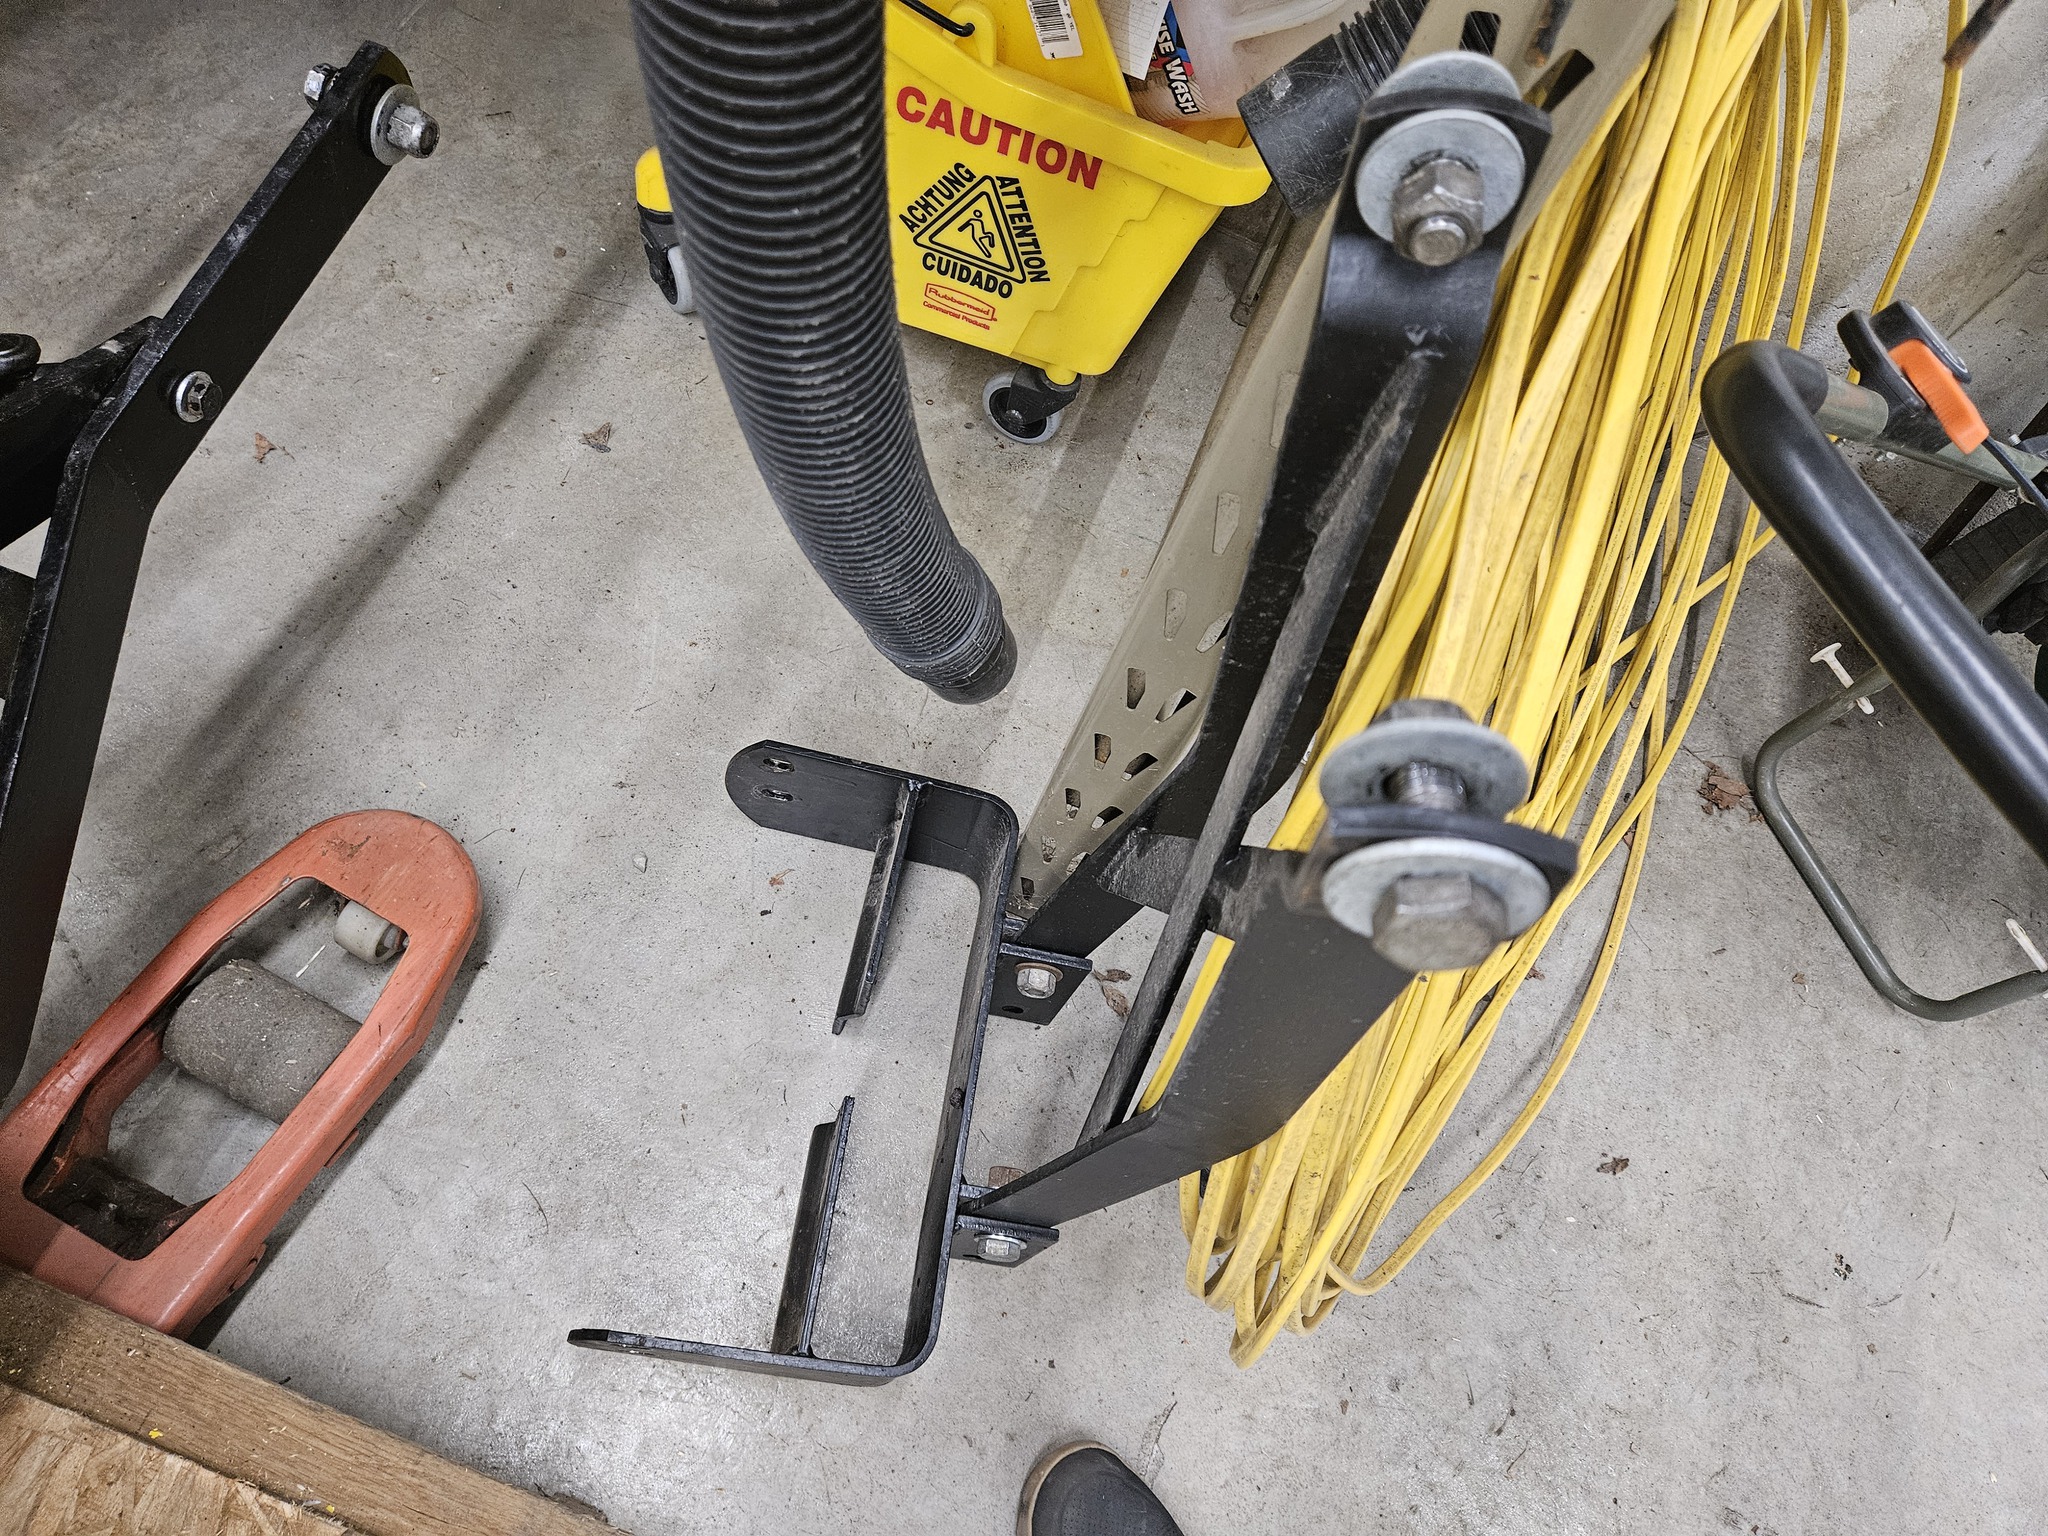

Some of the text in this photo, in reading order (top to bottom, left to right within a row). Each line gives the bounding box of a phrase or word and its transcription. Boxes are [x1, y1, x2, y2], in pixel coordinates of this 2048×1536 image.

[1165, 57, 1199, 113] WASH
[896, 86, 1103, 190] CAUTION
[899, 162, 977, 233] ACHTUNG
[995, 176, 1051, 283] ATTENTION
[922, 252, 1013, 299] CUIDADO
[929, 287, 990, 316] Rubbermaid
[923, 300, 990, 331] Commercial Products
